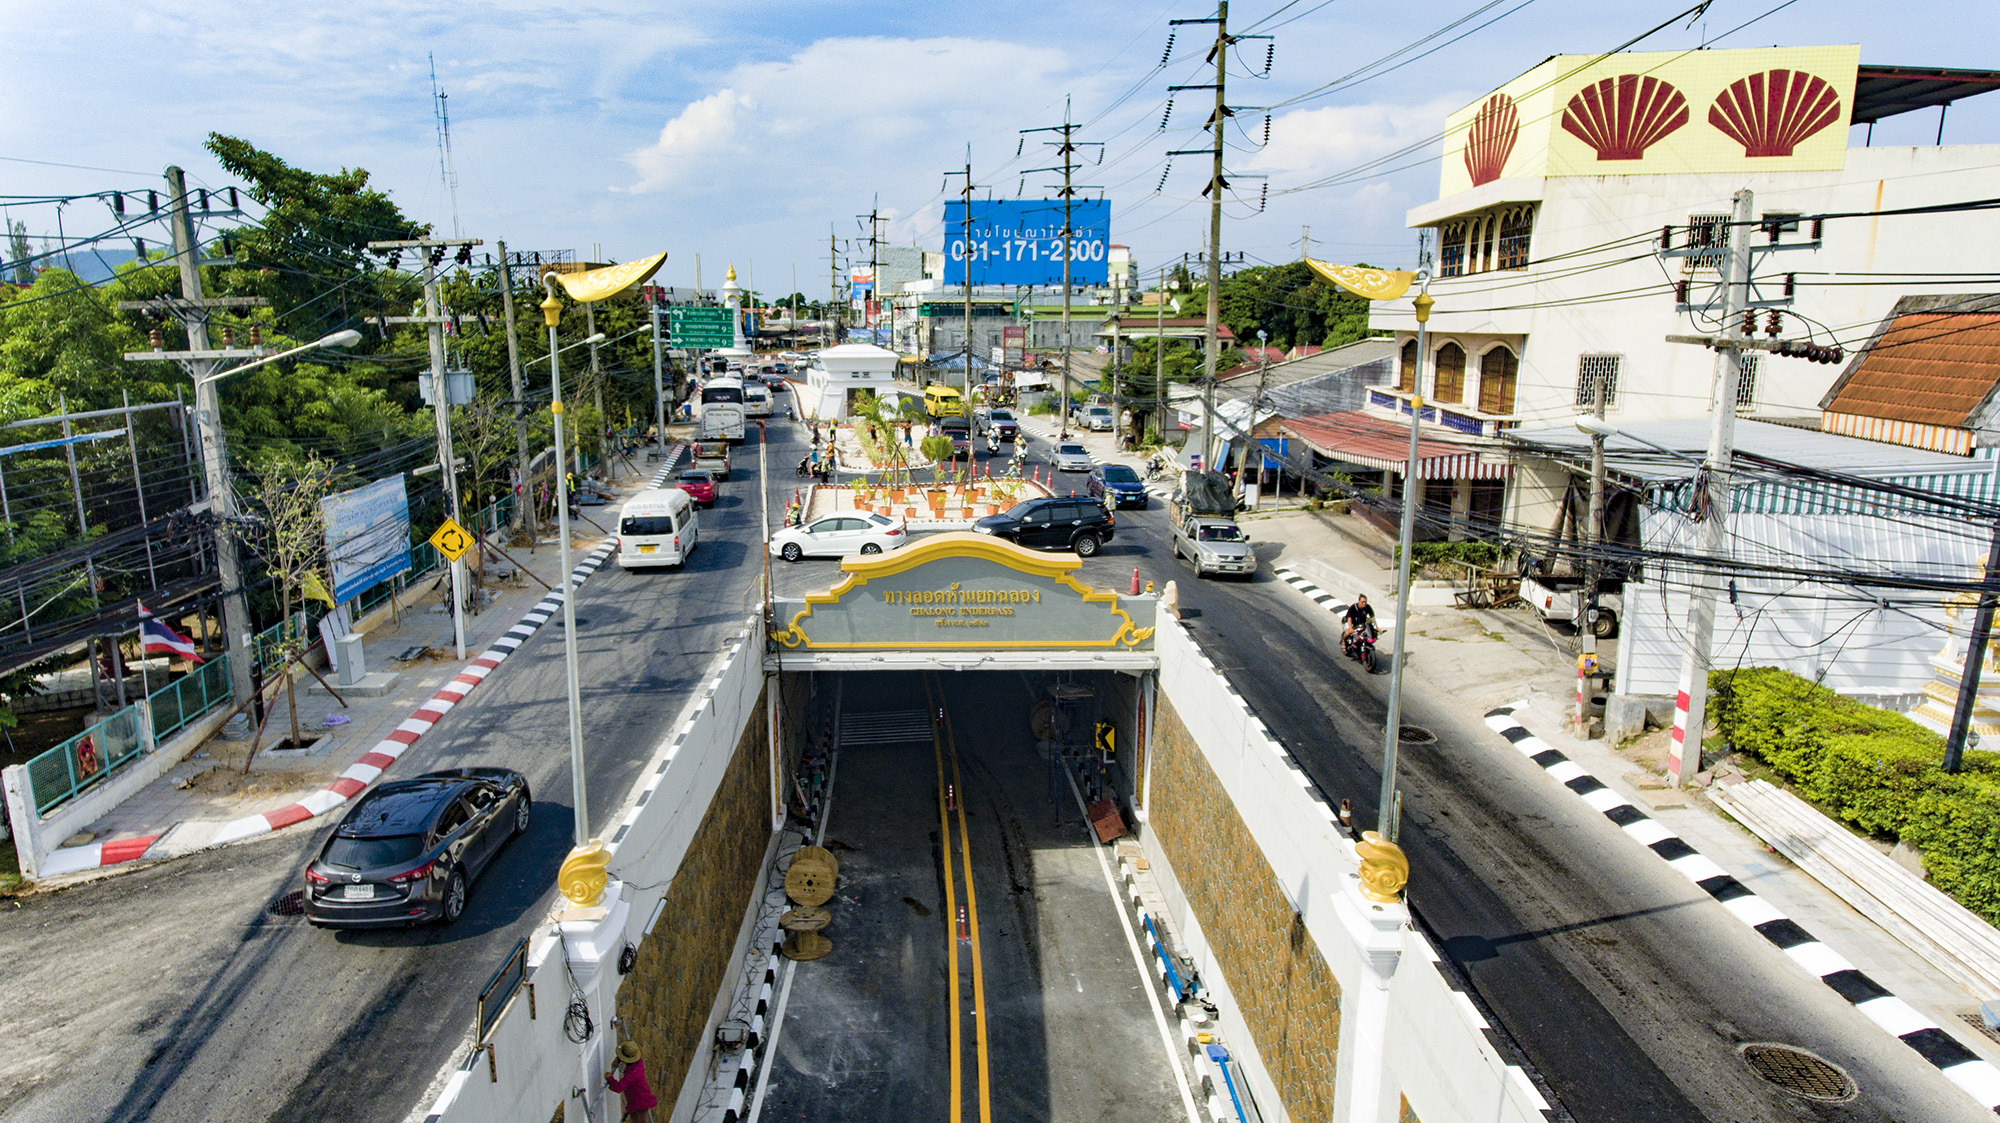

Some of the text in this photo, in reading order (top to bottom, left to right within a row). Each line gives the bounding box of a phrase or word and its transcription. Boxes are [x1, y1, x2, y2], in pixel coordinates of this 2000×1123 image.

[951, 239, 1104, 262] 081-171-2500
[883, 582, 1040, 604] ทางลอดห้าแยกฉลอง
[909, 607, 1013, 616] CHALONG UNDERPASS
